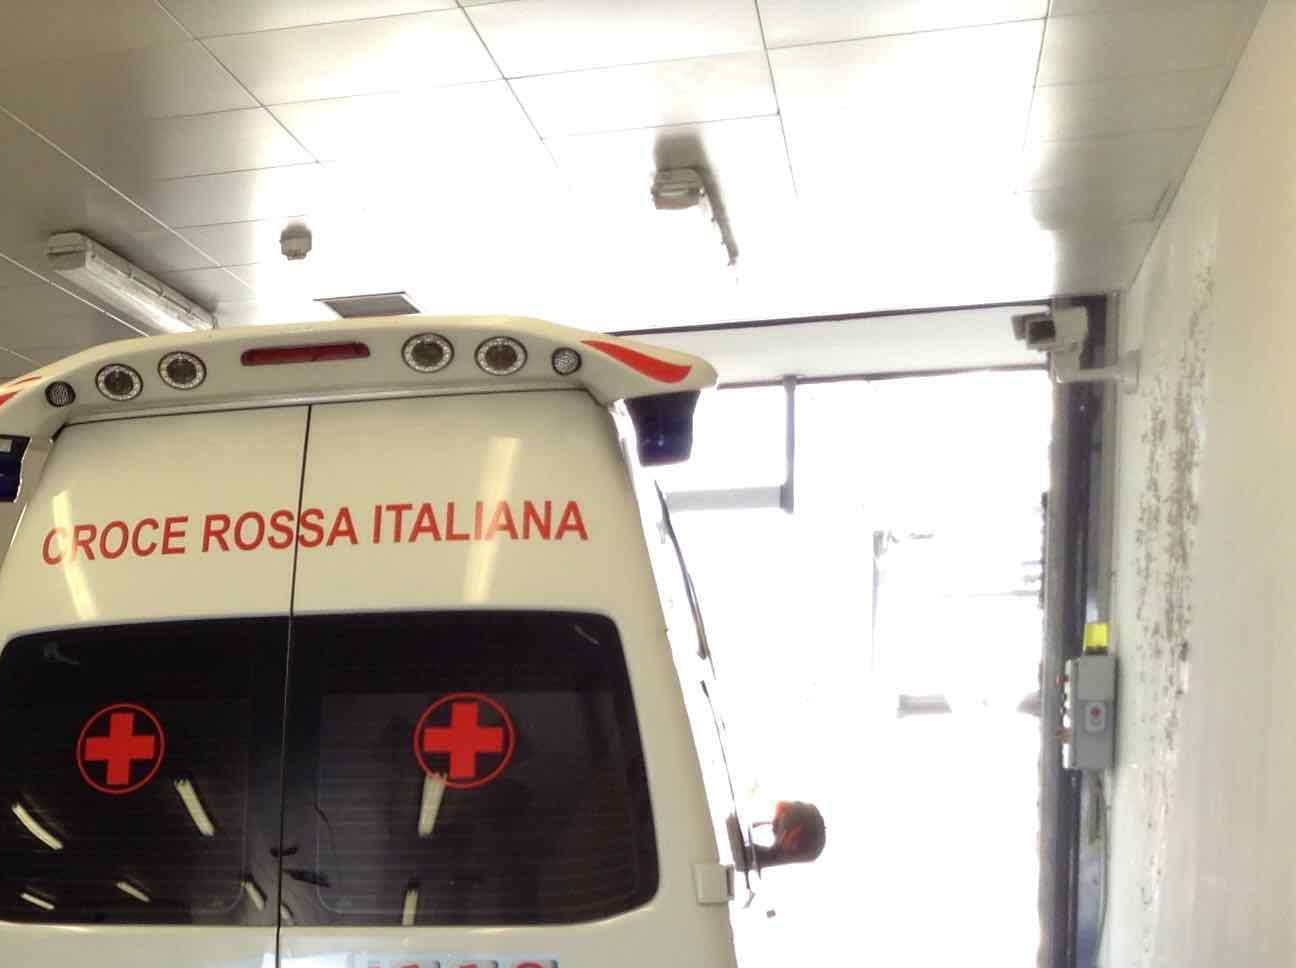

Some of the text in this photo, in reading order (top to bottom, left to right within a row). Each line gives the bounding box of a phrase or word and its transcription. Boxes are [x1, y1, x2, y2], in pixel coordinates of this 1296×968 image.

[41, 500, 590, 566] CROCE ROSSA ITALIANA
